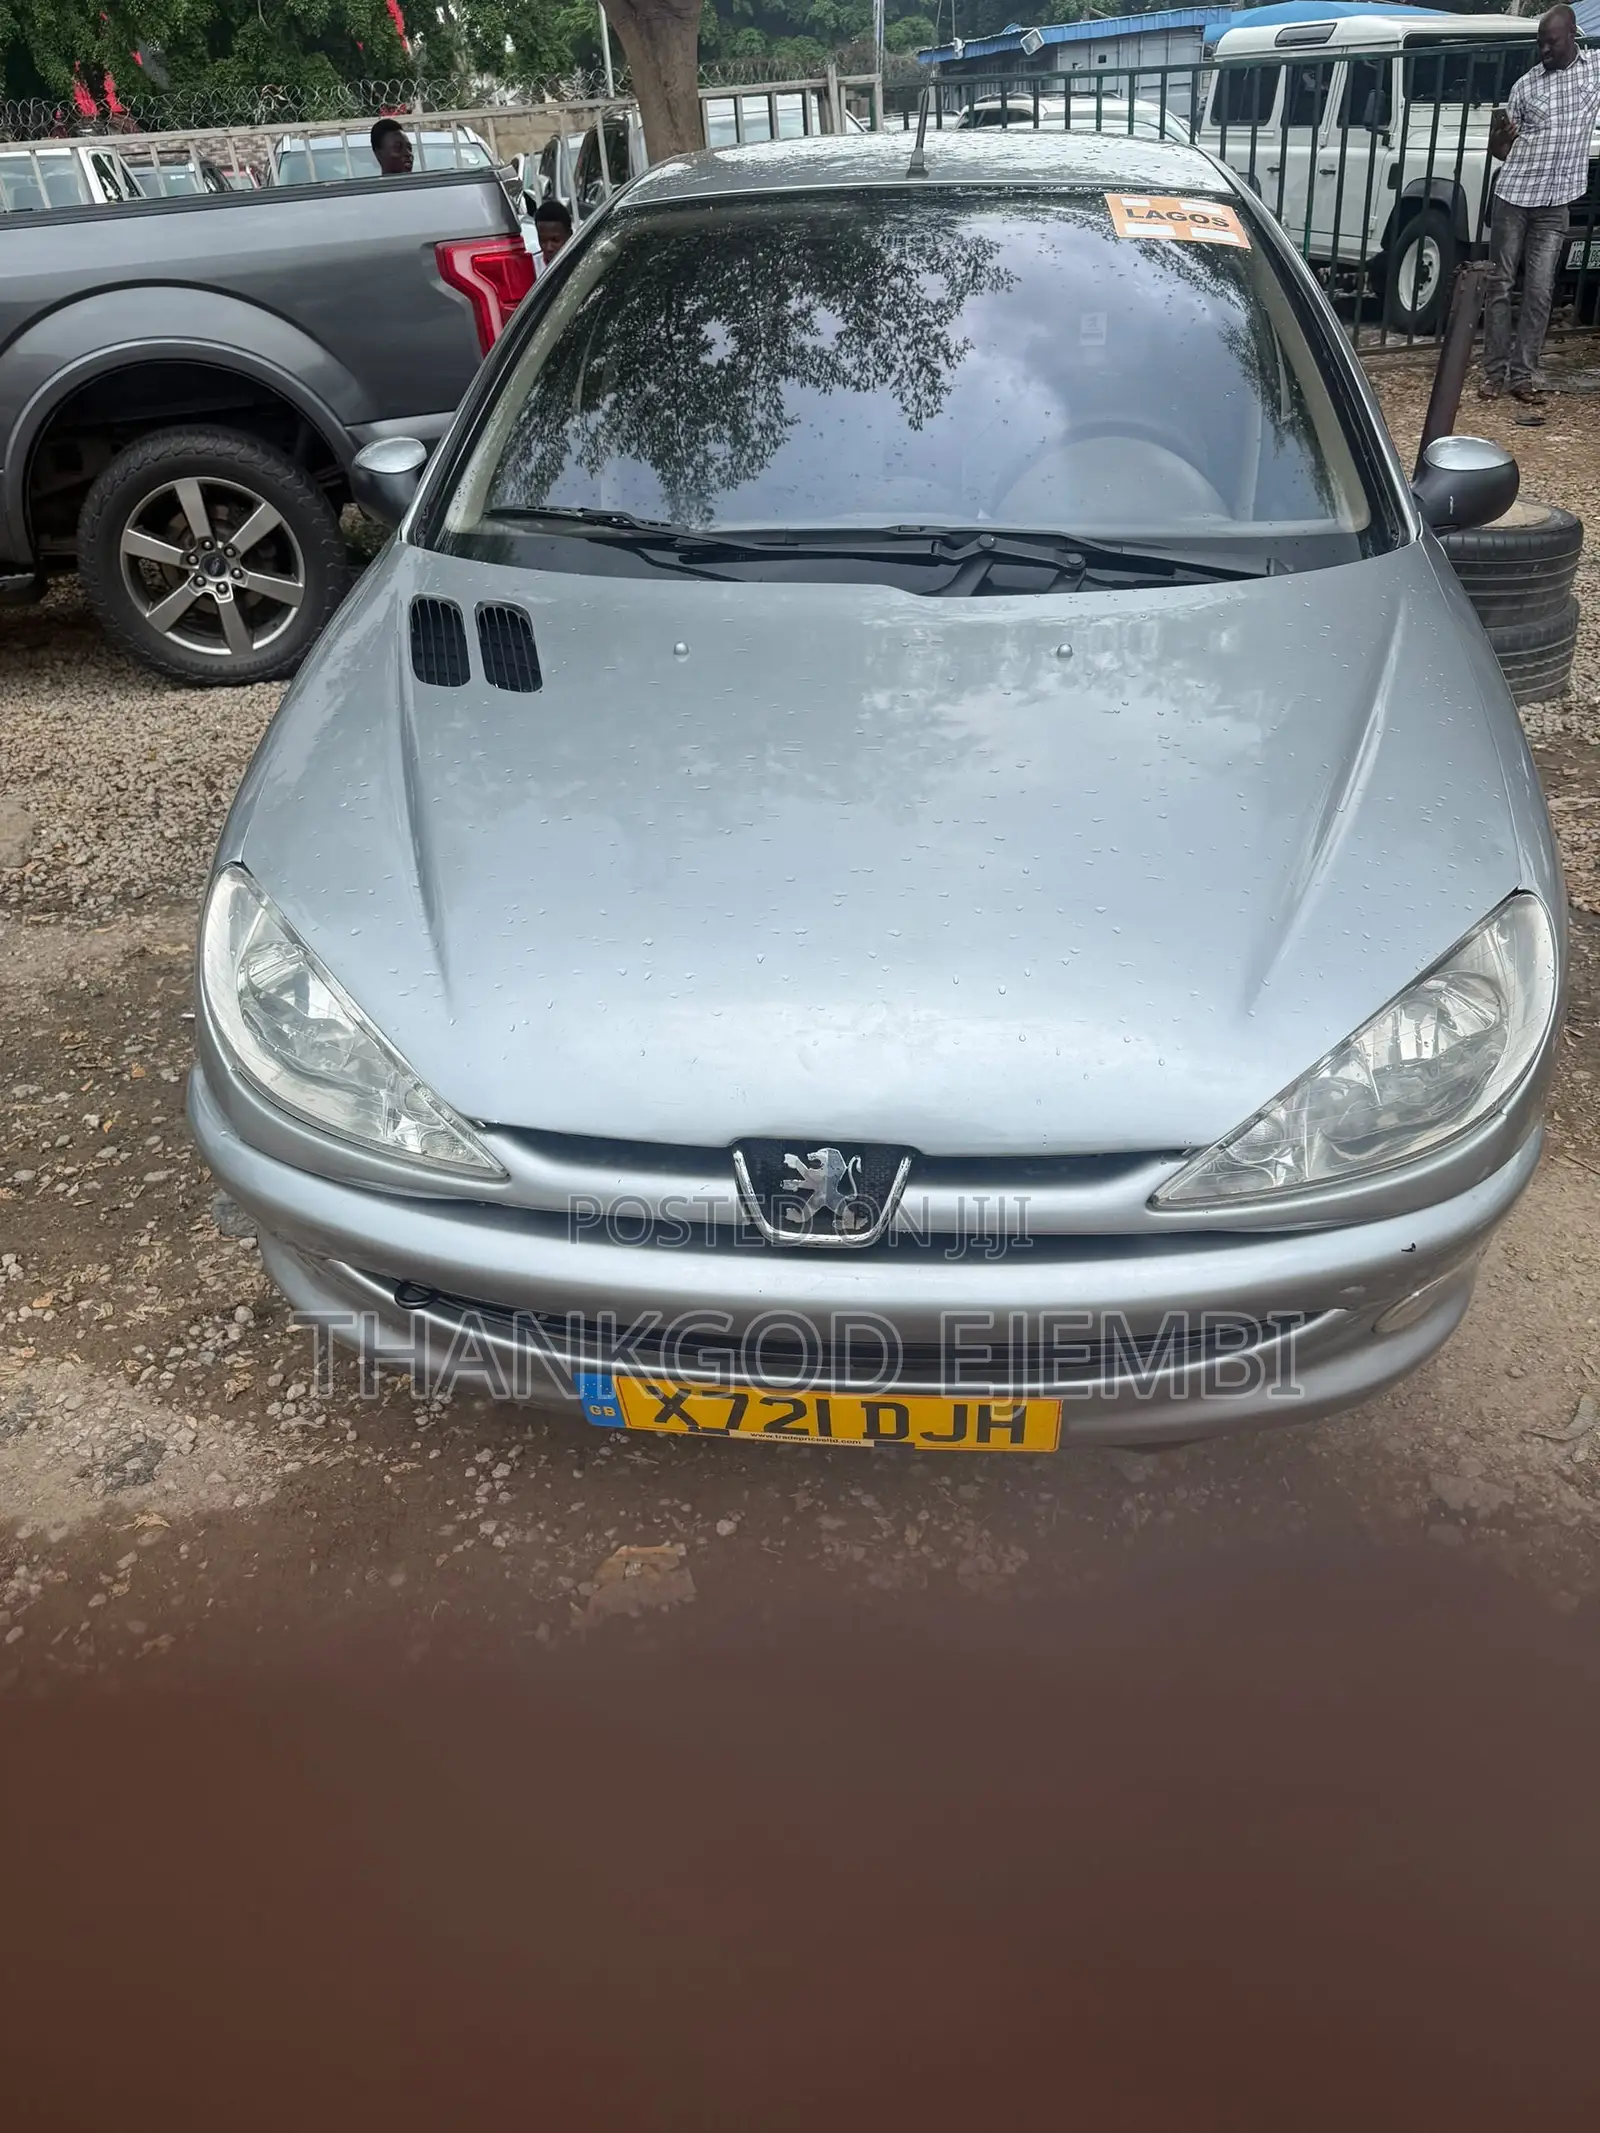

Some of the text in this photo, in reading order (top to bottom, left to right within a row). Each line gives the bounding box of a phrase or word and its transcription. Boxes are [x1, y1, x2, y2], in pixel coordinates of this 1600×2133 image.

[1125, 208, 1230, 228] LAGOS
[589, 1404, 616, 1417] GB
[646, 1384, 1028, 1444] X721 DJH
